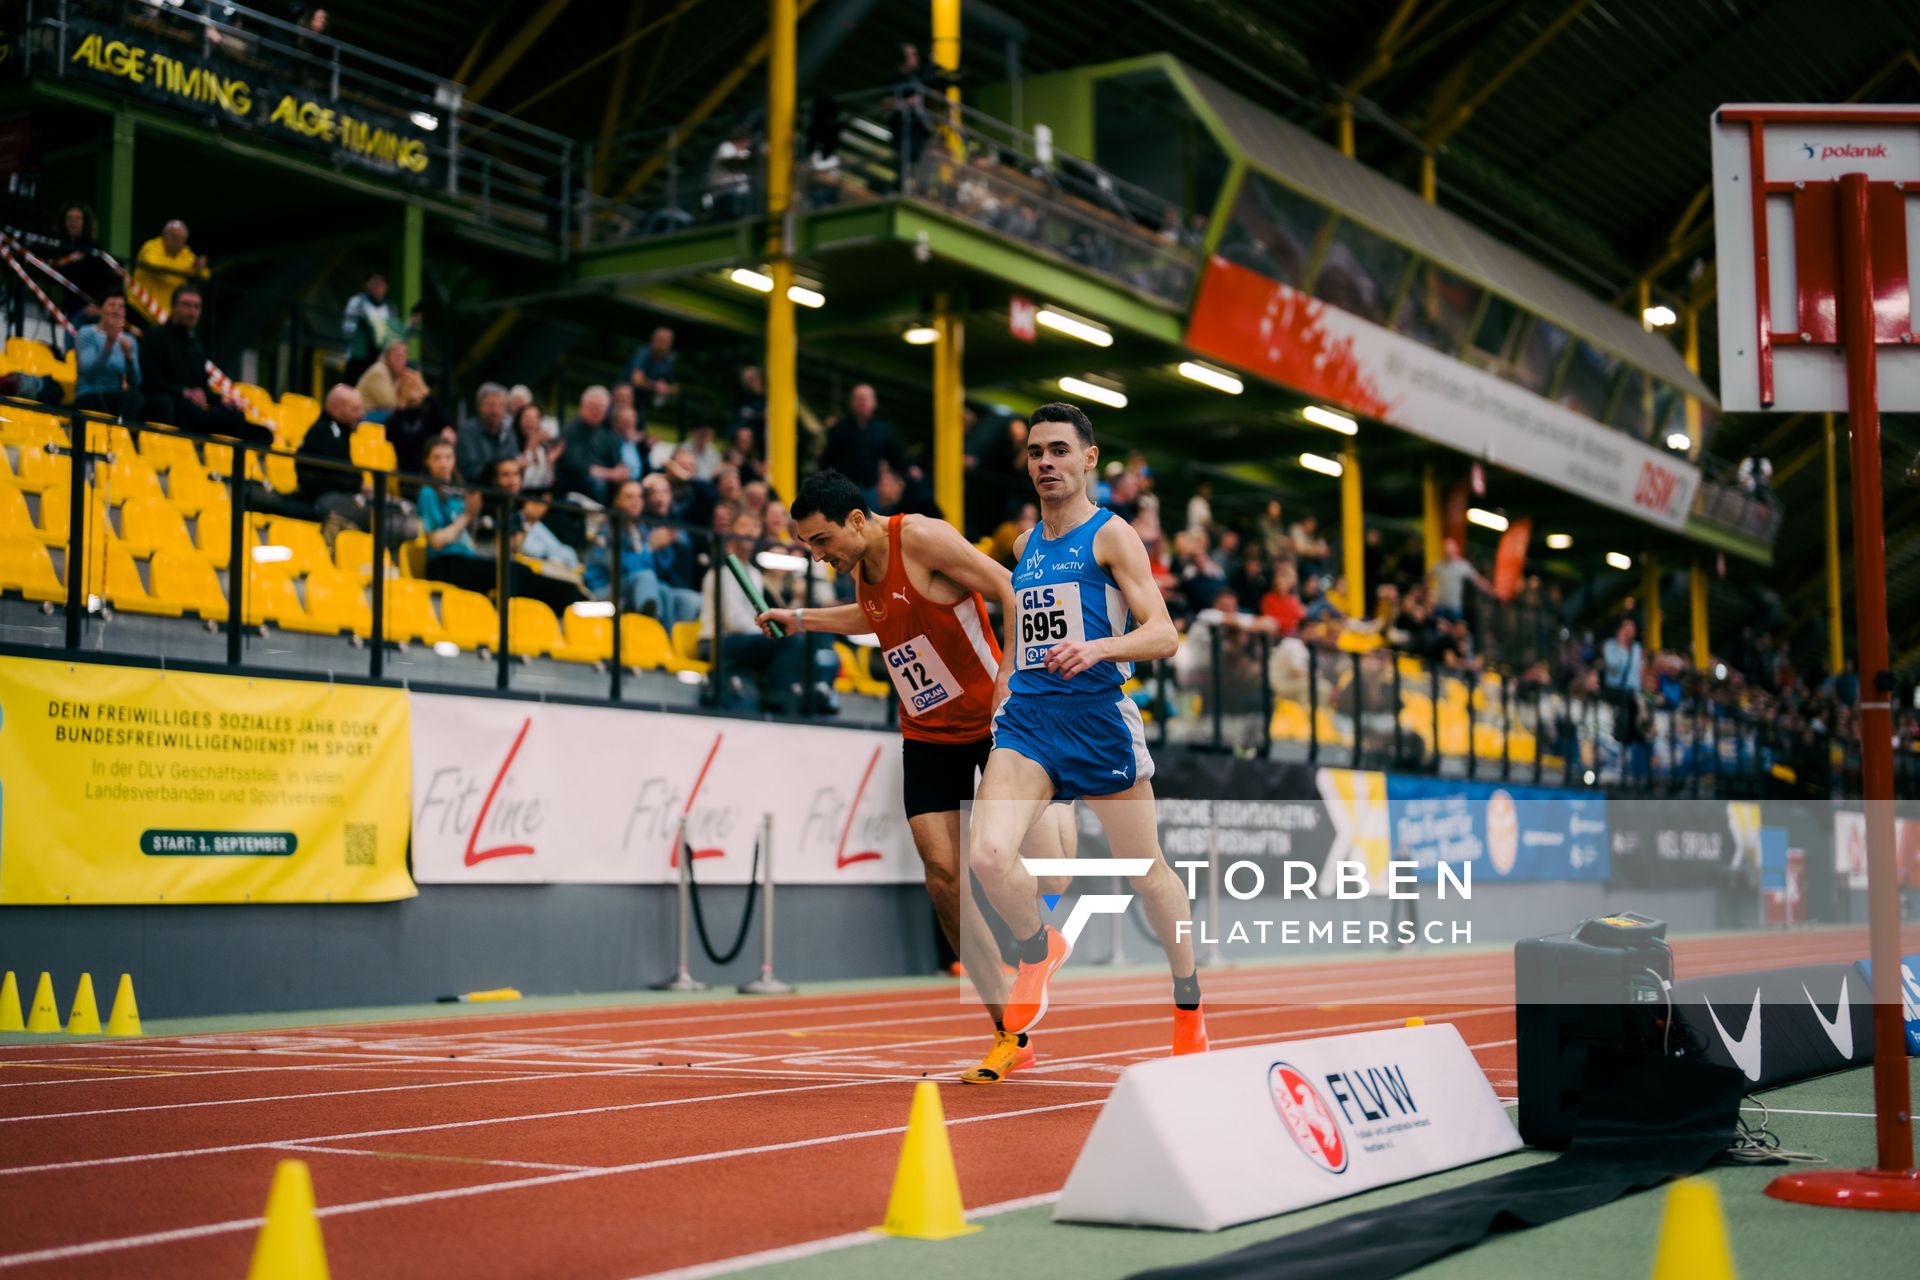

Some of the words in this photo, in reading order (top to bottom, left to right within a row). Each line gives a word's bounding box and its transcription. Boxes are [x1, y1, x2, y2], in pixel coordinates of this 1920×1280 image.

[71, 32, 252, 116] ALGE-TIMING
[1822, 144, 1886, 161] polanik
[1052, 561, 1084, 571] VIACTIV
[1022, 610, 1067, 643] 695
[901, 662, 933, 691] 12
[924, 686, 944, 701] PLAN
[48, 701, 90, 719] DEIN
[97, 704, 212, 728] FREIWILLIGES
[219, 712, 292, 732] SOZIALES
[298, 718, 335, 735] JAHR
[340, 720, 378, 737] ODER
[56, 725, 296, 754] BUNDESFREIWILLIGENDIENST
[302, 740, 319, 753] IM
[325, 741, 374, 757] SPORT
[92, 760, 105, 776] In
[110, 761, 133, 777] der
[138, 761, 166, 778] DLV
[85, 782, 216, 803] Landesverbänden
[219, 786, 246, 803] und
[416, 716, 545, 868] FitLine
[153, 836, 195, 851] START:
[199, 837, 211, 851] 1.
[213, 837, 287, 852] SEPTEMBER
[1325, 1063, 1417, 1125] FLVW
